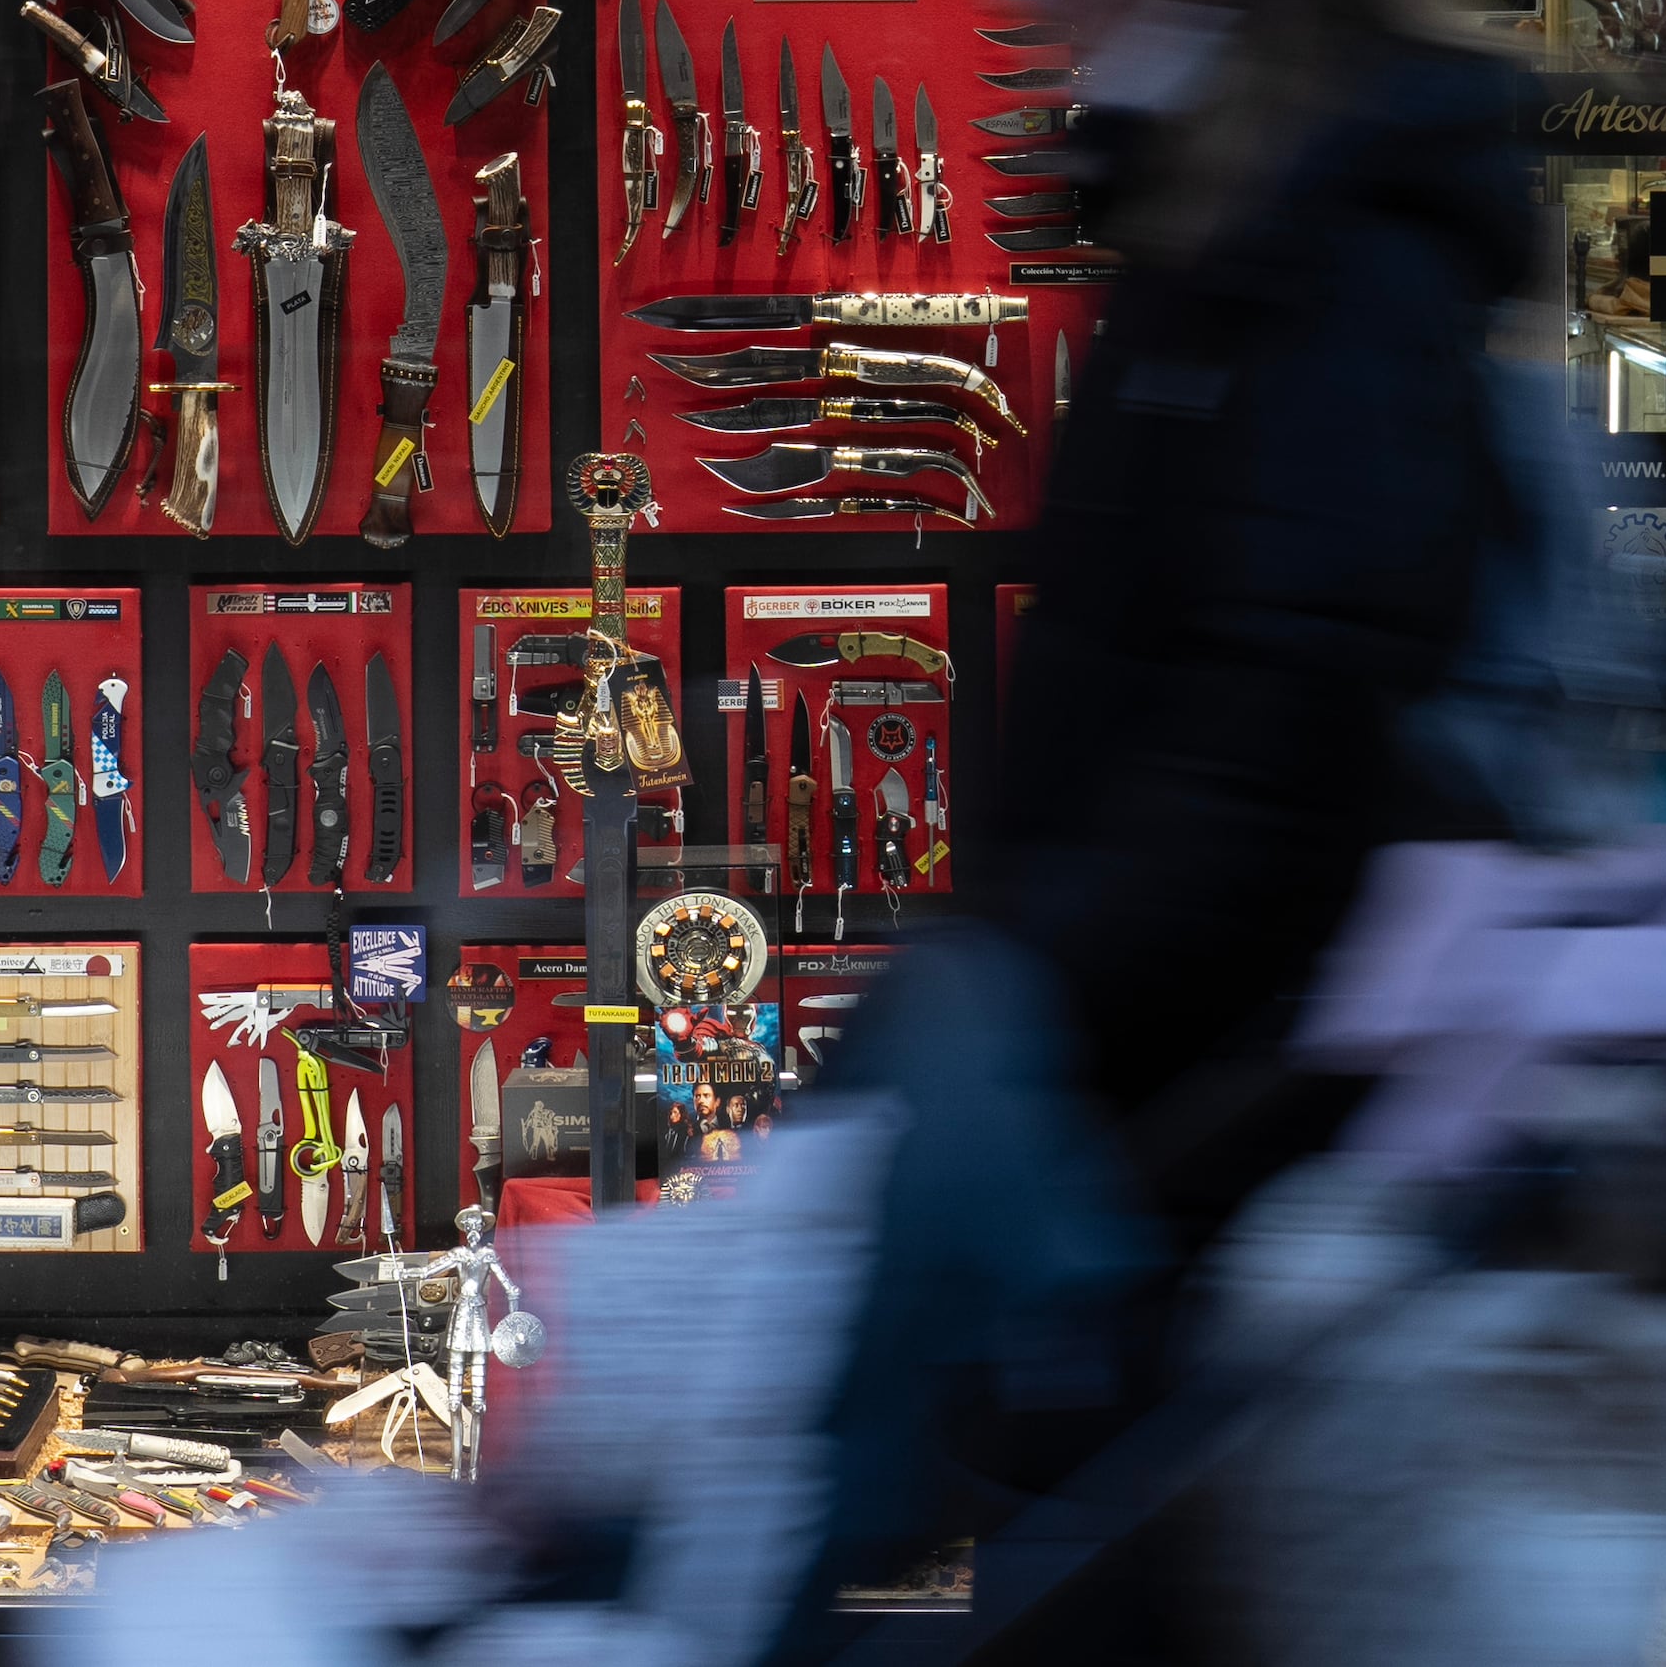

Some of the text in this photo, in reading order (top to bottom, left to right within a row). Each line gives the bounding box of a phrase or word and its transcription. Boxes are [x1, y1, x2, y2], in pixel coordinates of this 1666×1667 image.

[1021, 267, 1083, 278] Colección Navajas
[482, 601, 658, 614] EDC KNIVES lsillo
[758, 601, 800, 611] GERBER
[821, 598, 875, 610] BÖKER
[718, 698, 748, 707] GERBE
[657, 898, 687, 919] THAT
[694, 894, 728, 910] TONY
[733, 906, 760, 940] STARK
[353, 931, 397, 955] EXCELLENCE
[533, 963, 588, 973] Acero Dam
[798, 960, 891, 970] FOX KNIVES
[353, 975, 396, 997] ATTITUDE
[588, 1009, 636, 1018] TUTANKAMON
[662, 1061, 773, 1085] IRON MAN 2
